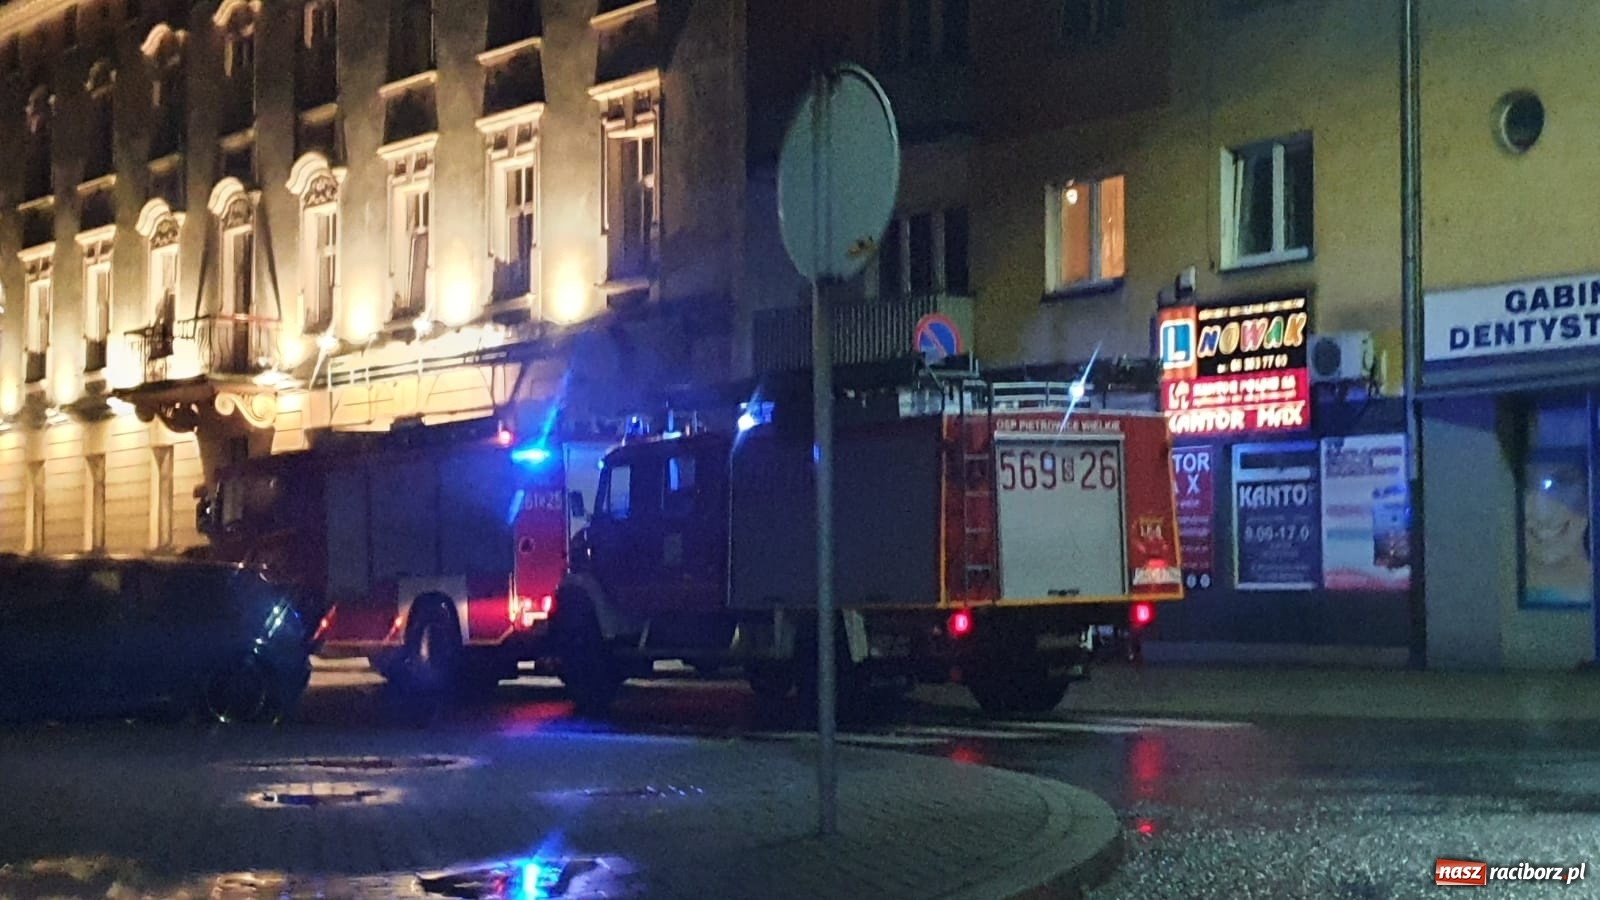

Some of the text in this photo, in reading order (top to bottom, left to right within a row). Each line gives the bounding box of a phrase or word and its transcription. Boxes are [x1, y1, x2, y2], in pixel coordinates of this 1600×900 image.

[1197, 312, 1307, 358] NOWAK
[1449, 312, 1600, 351] DENTYST
[1019, 419, 1079, 431] PIETROWCE
[1257, 404, 1304, 428] MAX
